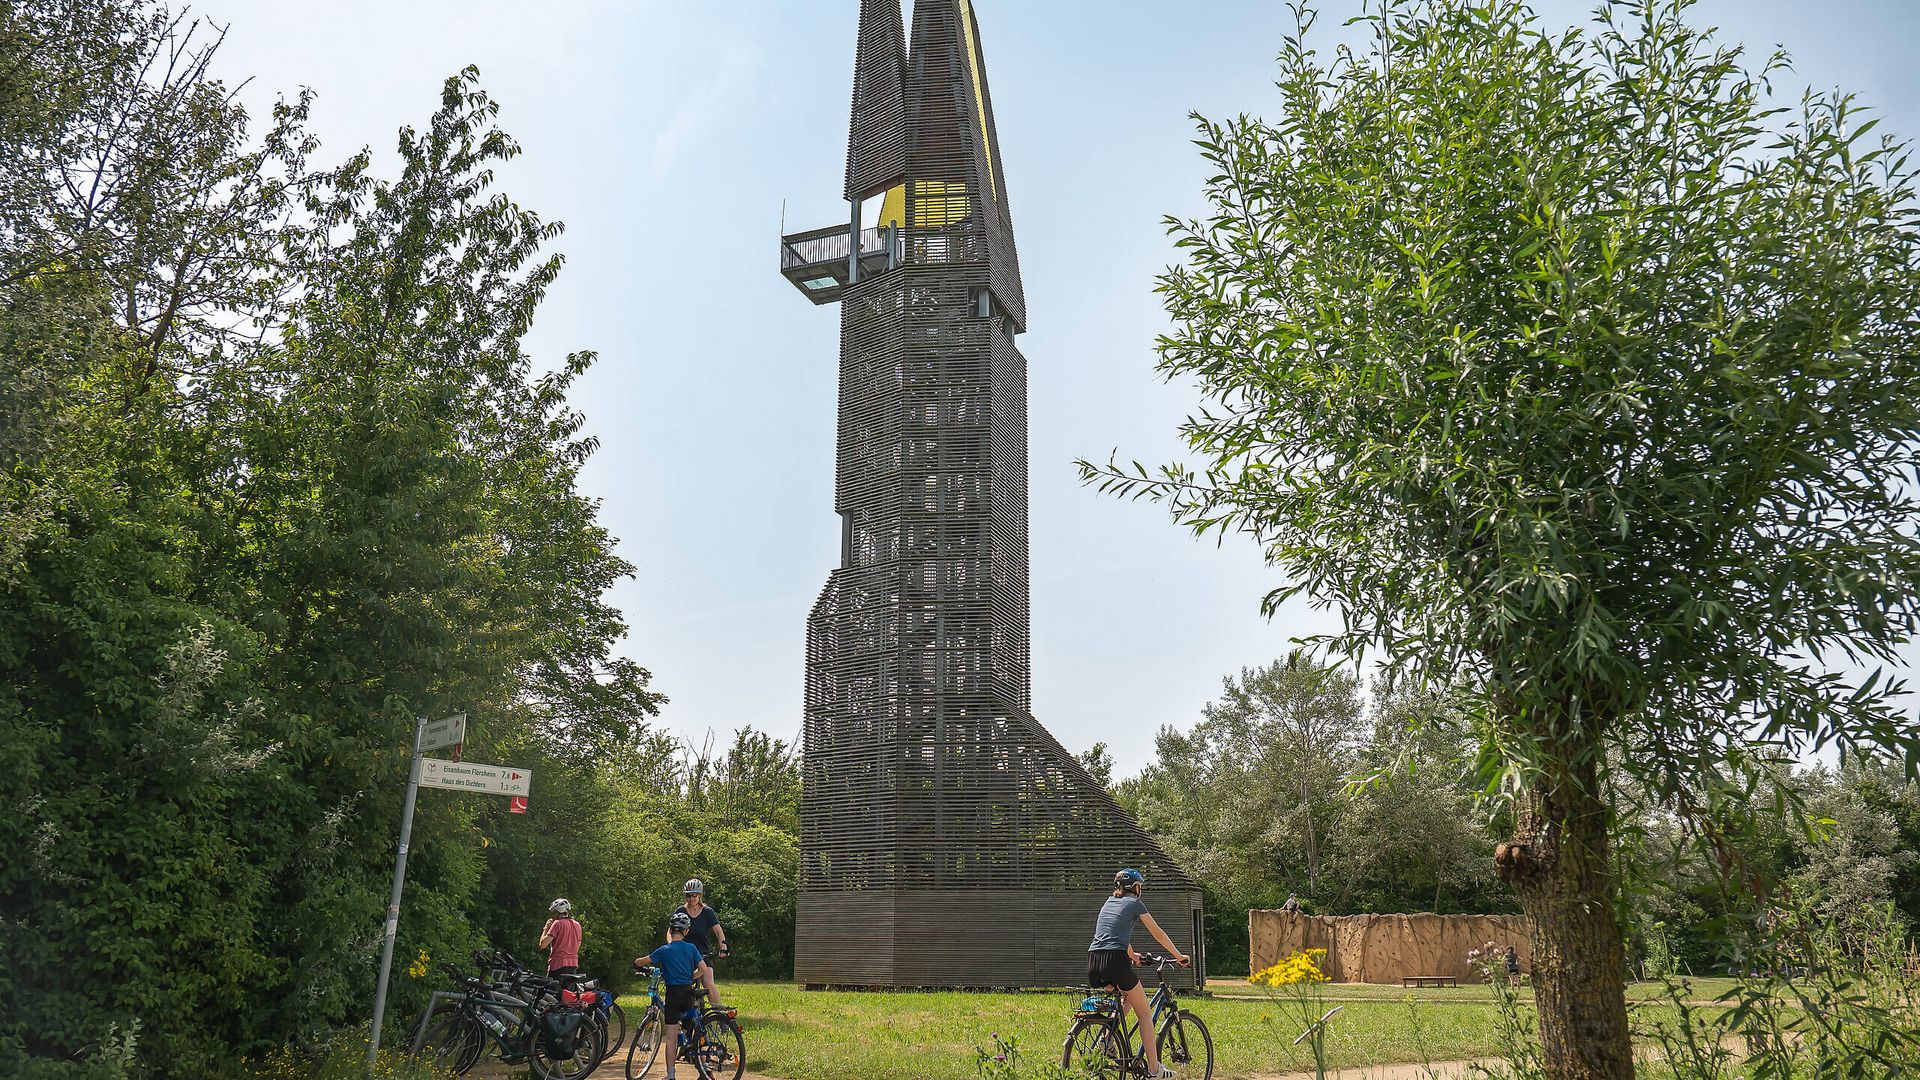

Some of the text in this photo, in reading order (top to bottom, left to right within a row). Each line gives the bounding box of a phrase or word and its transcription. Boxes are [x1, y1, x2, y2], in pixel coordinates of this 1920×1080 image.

[443, 765, 471, 775] Eisenbaum
[441, 777, 455, 785] Haus
[455, 778, 465, 786] des
[465, 779, 486, 788] Dichters
